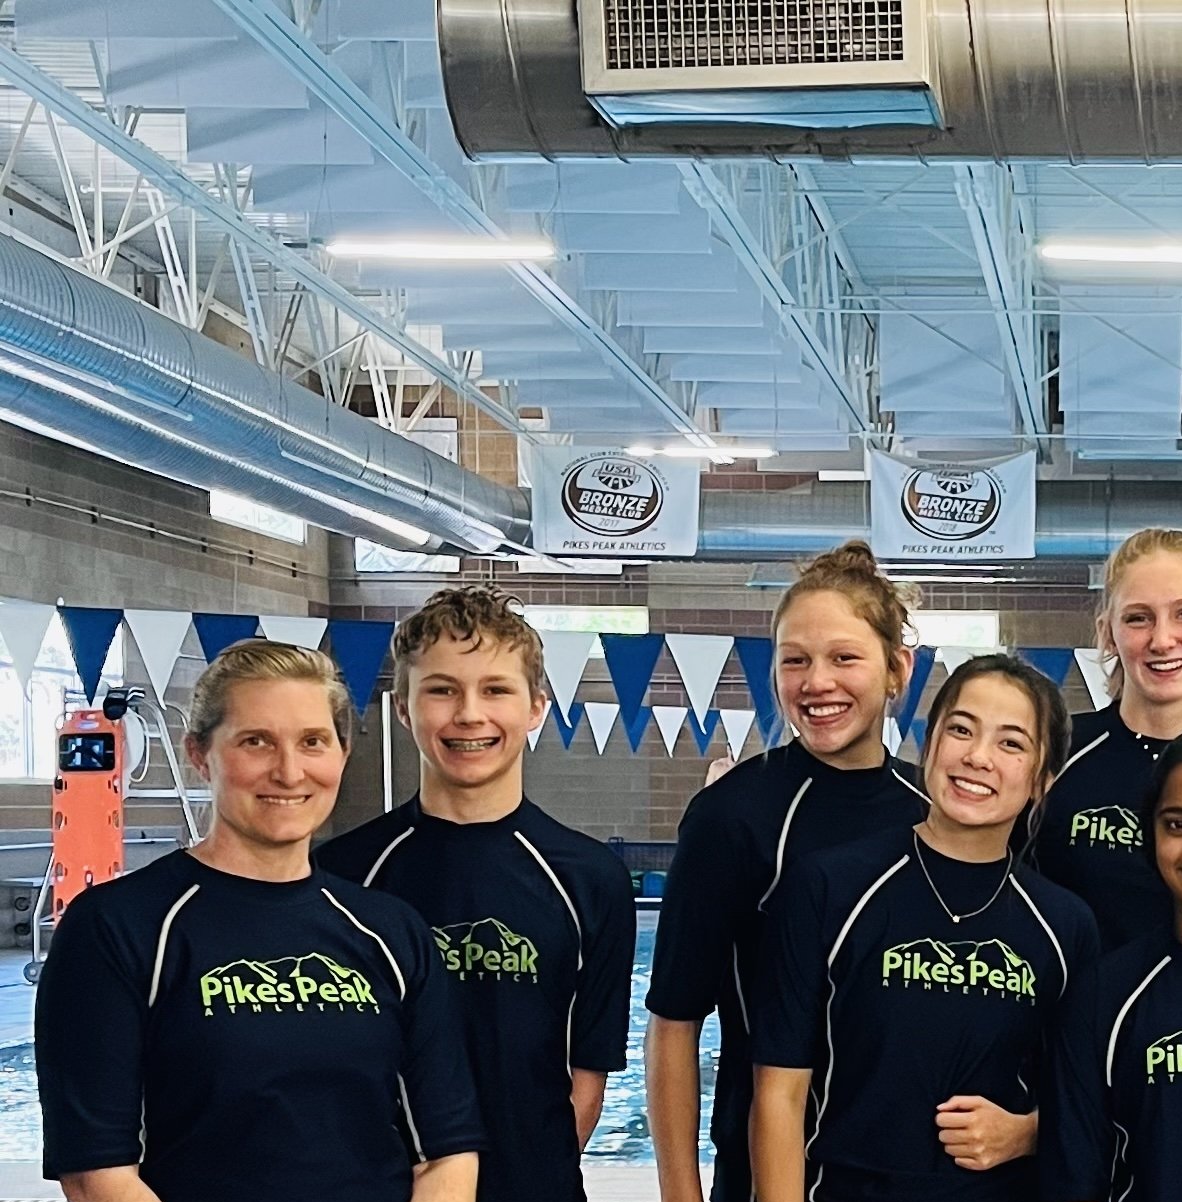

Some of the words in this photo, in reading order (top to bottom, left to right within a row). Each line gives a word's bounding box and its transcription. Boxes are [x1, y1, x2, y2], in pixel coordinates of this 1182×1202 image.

[603, 464, 632, 475] USA
[579, 490, 649, 512] BRONZE
[918, 495, 988, 516] BRONZE
[580, 504, 614, 516] MEDAL
[616, 508, 642, 519] CLUB
[918, 508, 952, 520] MEDAL
[955, 512, 980, 522] CLUB
[562, 541, 589, 550] PIKES
[592, 541, 616, 551] PEAK
[619, 541, 667, 551] ATHLETICS
[902, 544, 928, 554] PIKES
[930, 545, 955, 554] PEAK
[958, 545, 1004, 554] ATHLETICS
[466, 943, 539, 973] Peak
[883, 951, 965, 985] Pikes
[970, 960, 1036, 996] Peak
[200, 975, 295, 1006] Pikes
[295, 976, 378, 1005] Peak
